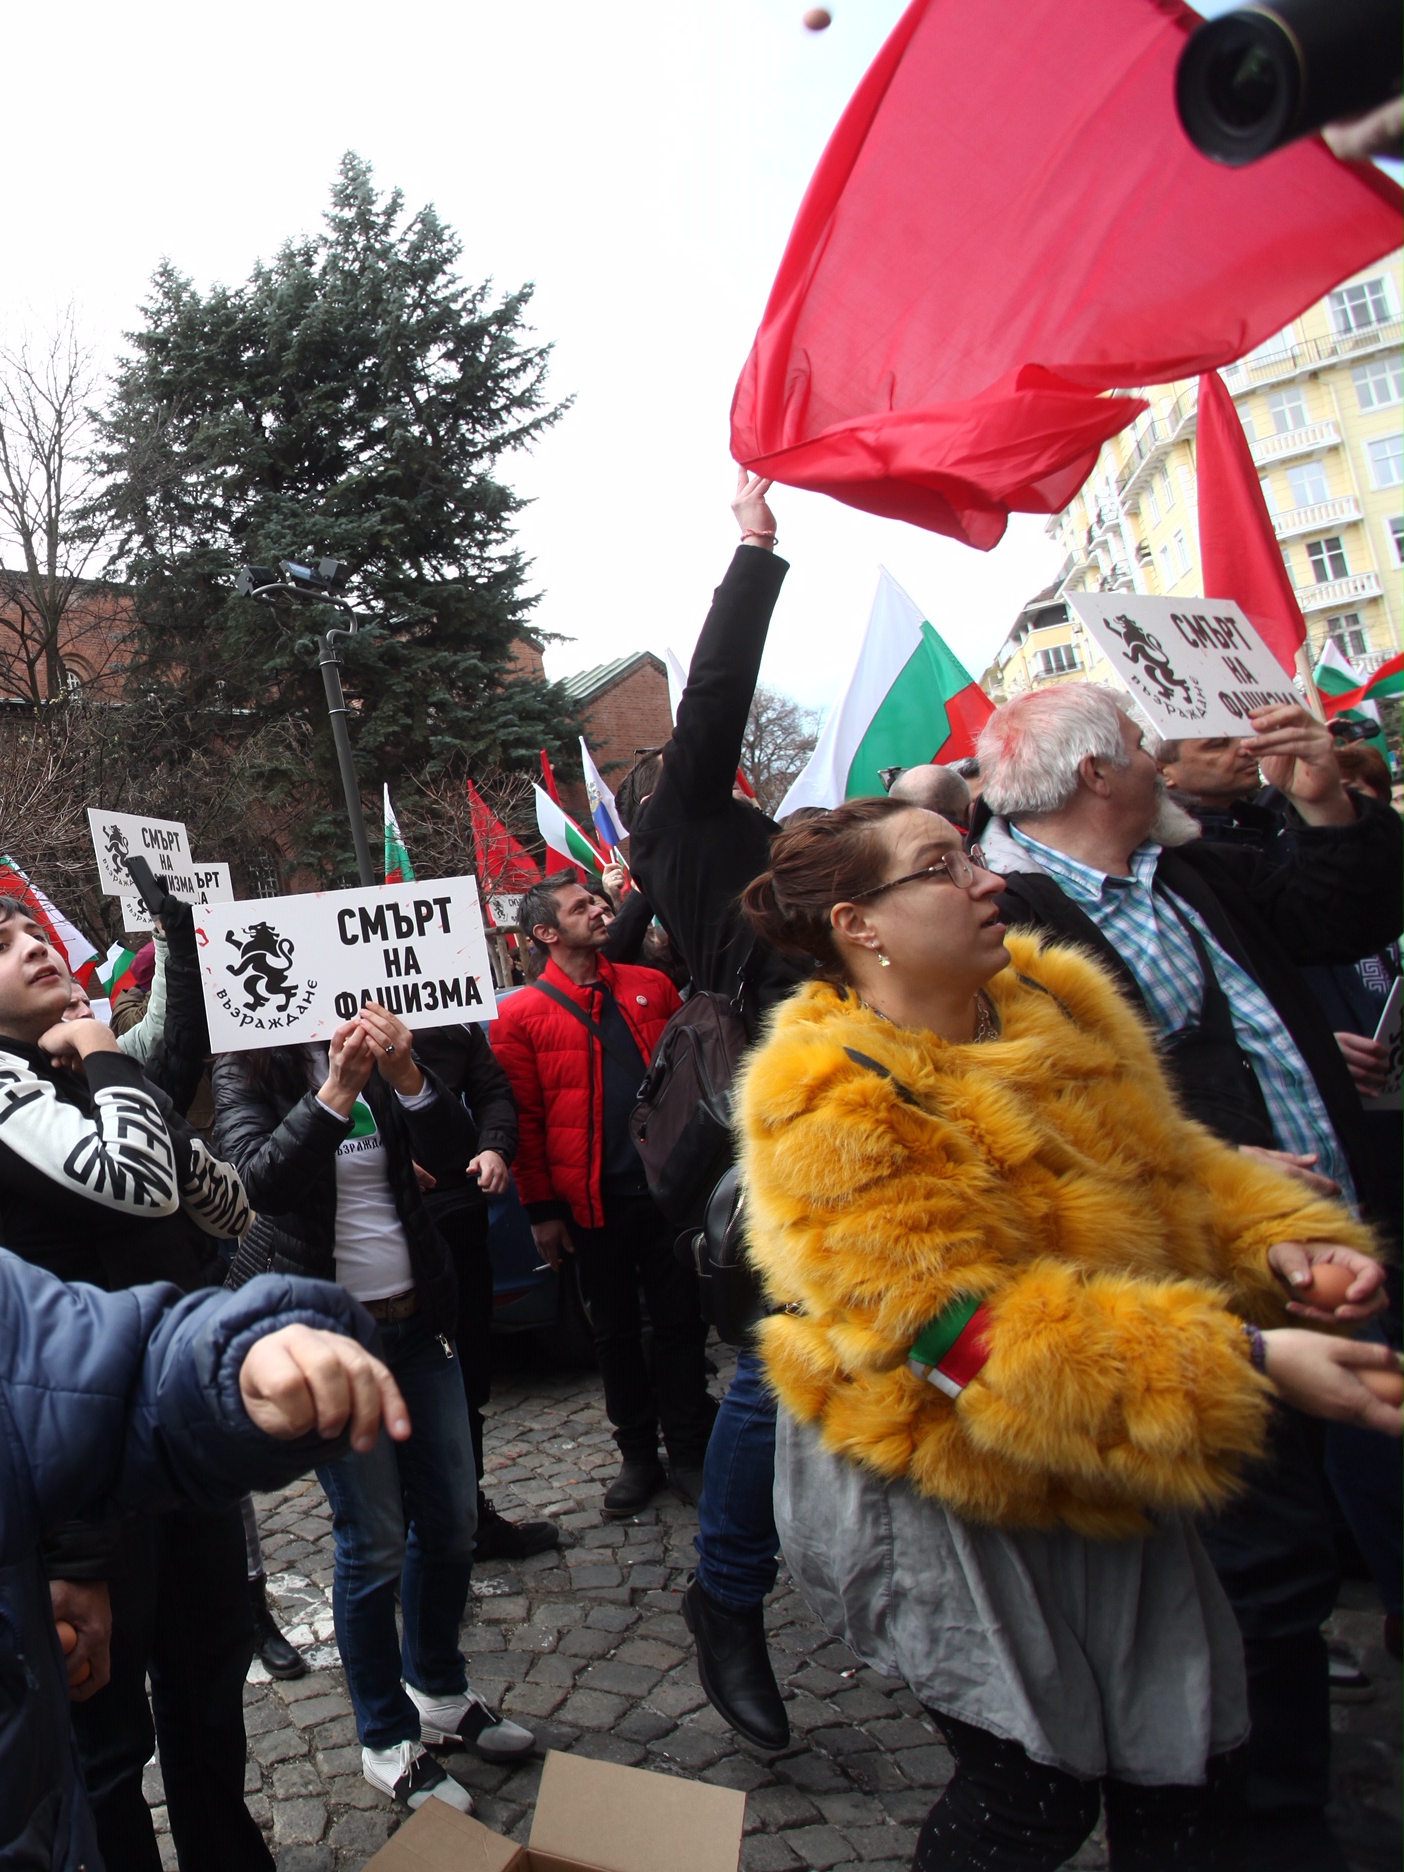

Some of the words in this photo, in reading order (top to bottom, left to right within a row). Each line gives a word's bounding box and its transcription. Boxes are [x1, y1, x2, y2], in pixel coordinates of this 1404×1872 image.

[1170, 613, 1252, 650] СМЪРТ
[1221, 656, 1260, 685] НА
[141, 827, 181, 852] СМЪРТ
[159, 854, 174, 871] НА
[337, 897, 453, 946] СМЪРТ
[383, 946, 423, 978] НА
